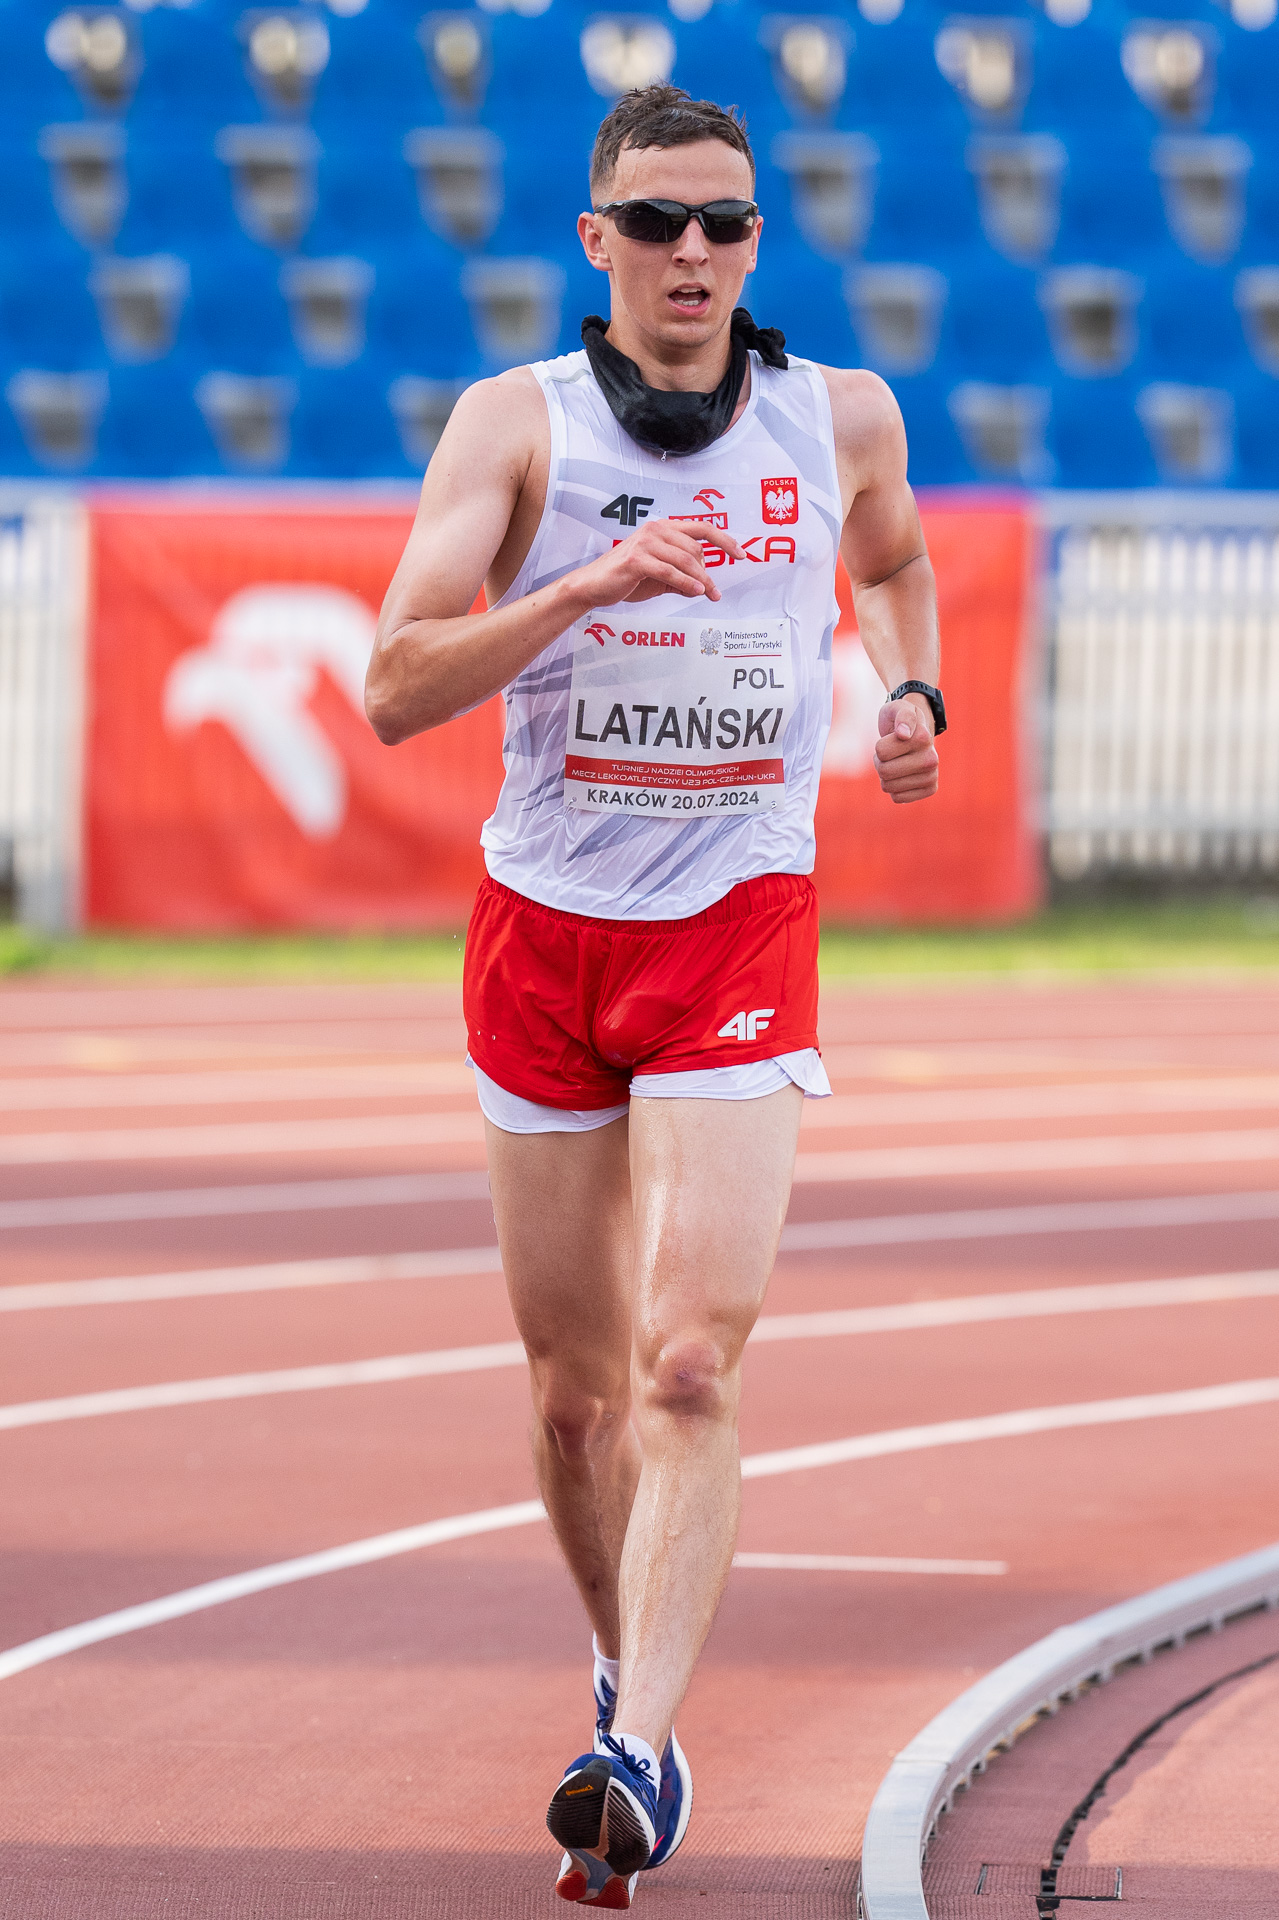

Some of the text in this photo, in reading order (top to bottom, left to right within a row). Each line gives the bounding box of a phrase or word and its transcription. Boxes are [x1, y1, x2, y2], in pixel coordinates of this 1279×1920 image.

[763, 479, 795, 487] POLSKA
[600, 493, 654, 527] 4F
[612, 536, 796, 568] SKA
[621, 630, 685, 647] ORLEN
[724, 631, 768, 640] Ministerstwo
[723, 641, 747, 651] Sportu
[752, 640, 782, 650] Turystyki
[733, 667, 784, 690] POL
[574, 696, 783, 750] LATAŃSKI
[571, 769, 776, 786] MECZ LEKKOATLETYCZNY U23 POL-CZE-HUN-UKR
[611, 763, 740, 777] TURNIEJ NADZIEI OLIMPIJSKICH
[587, 788, 760, 810] KRAKÓW 20.07.2024
[717, 1008, 775, 1041] 4F
